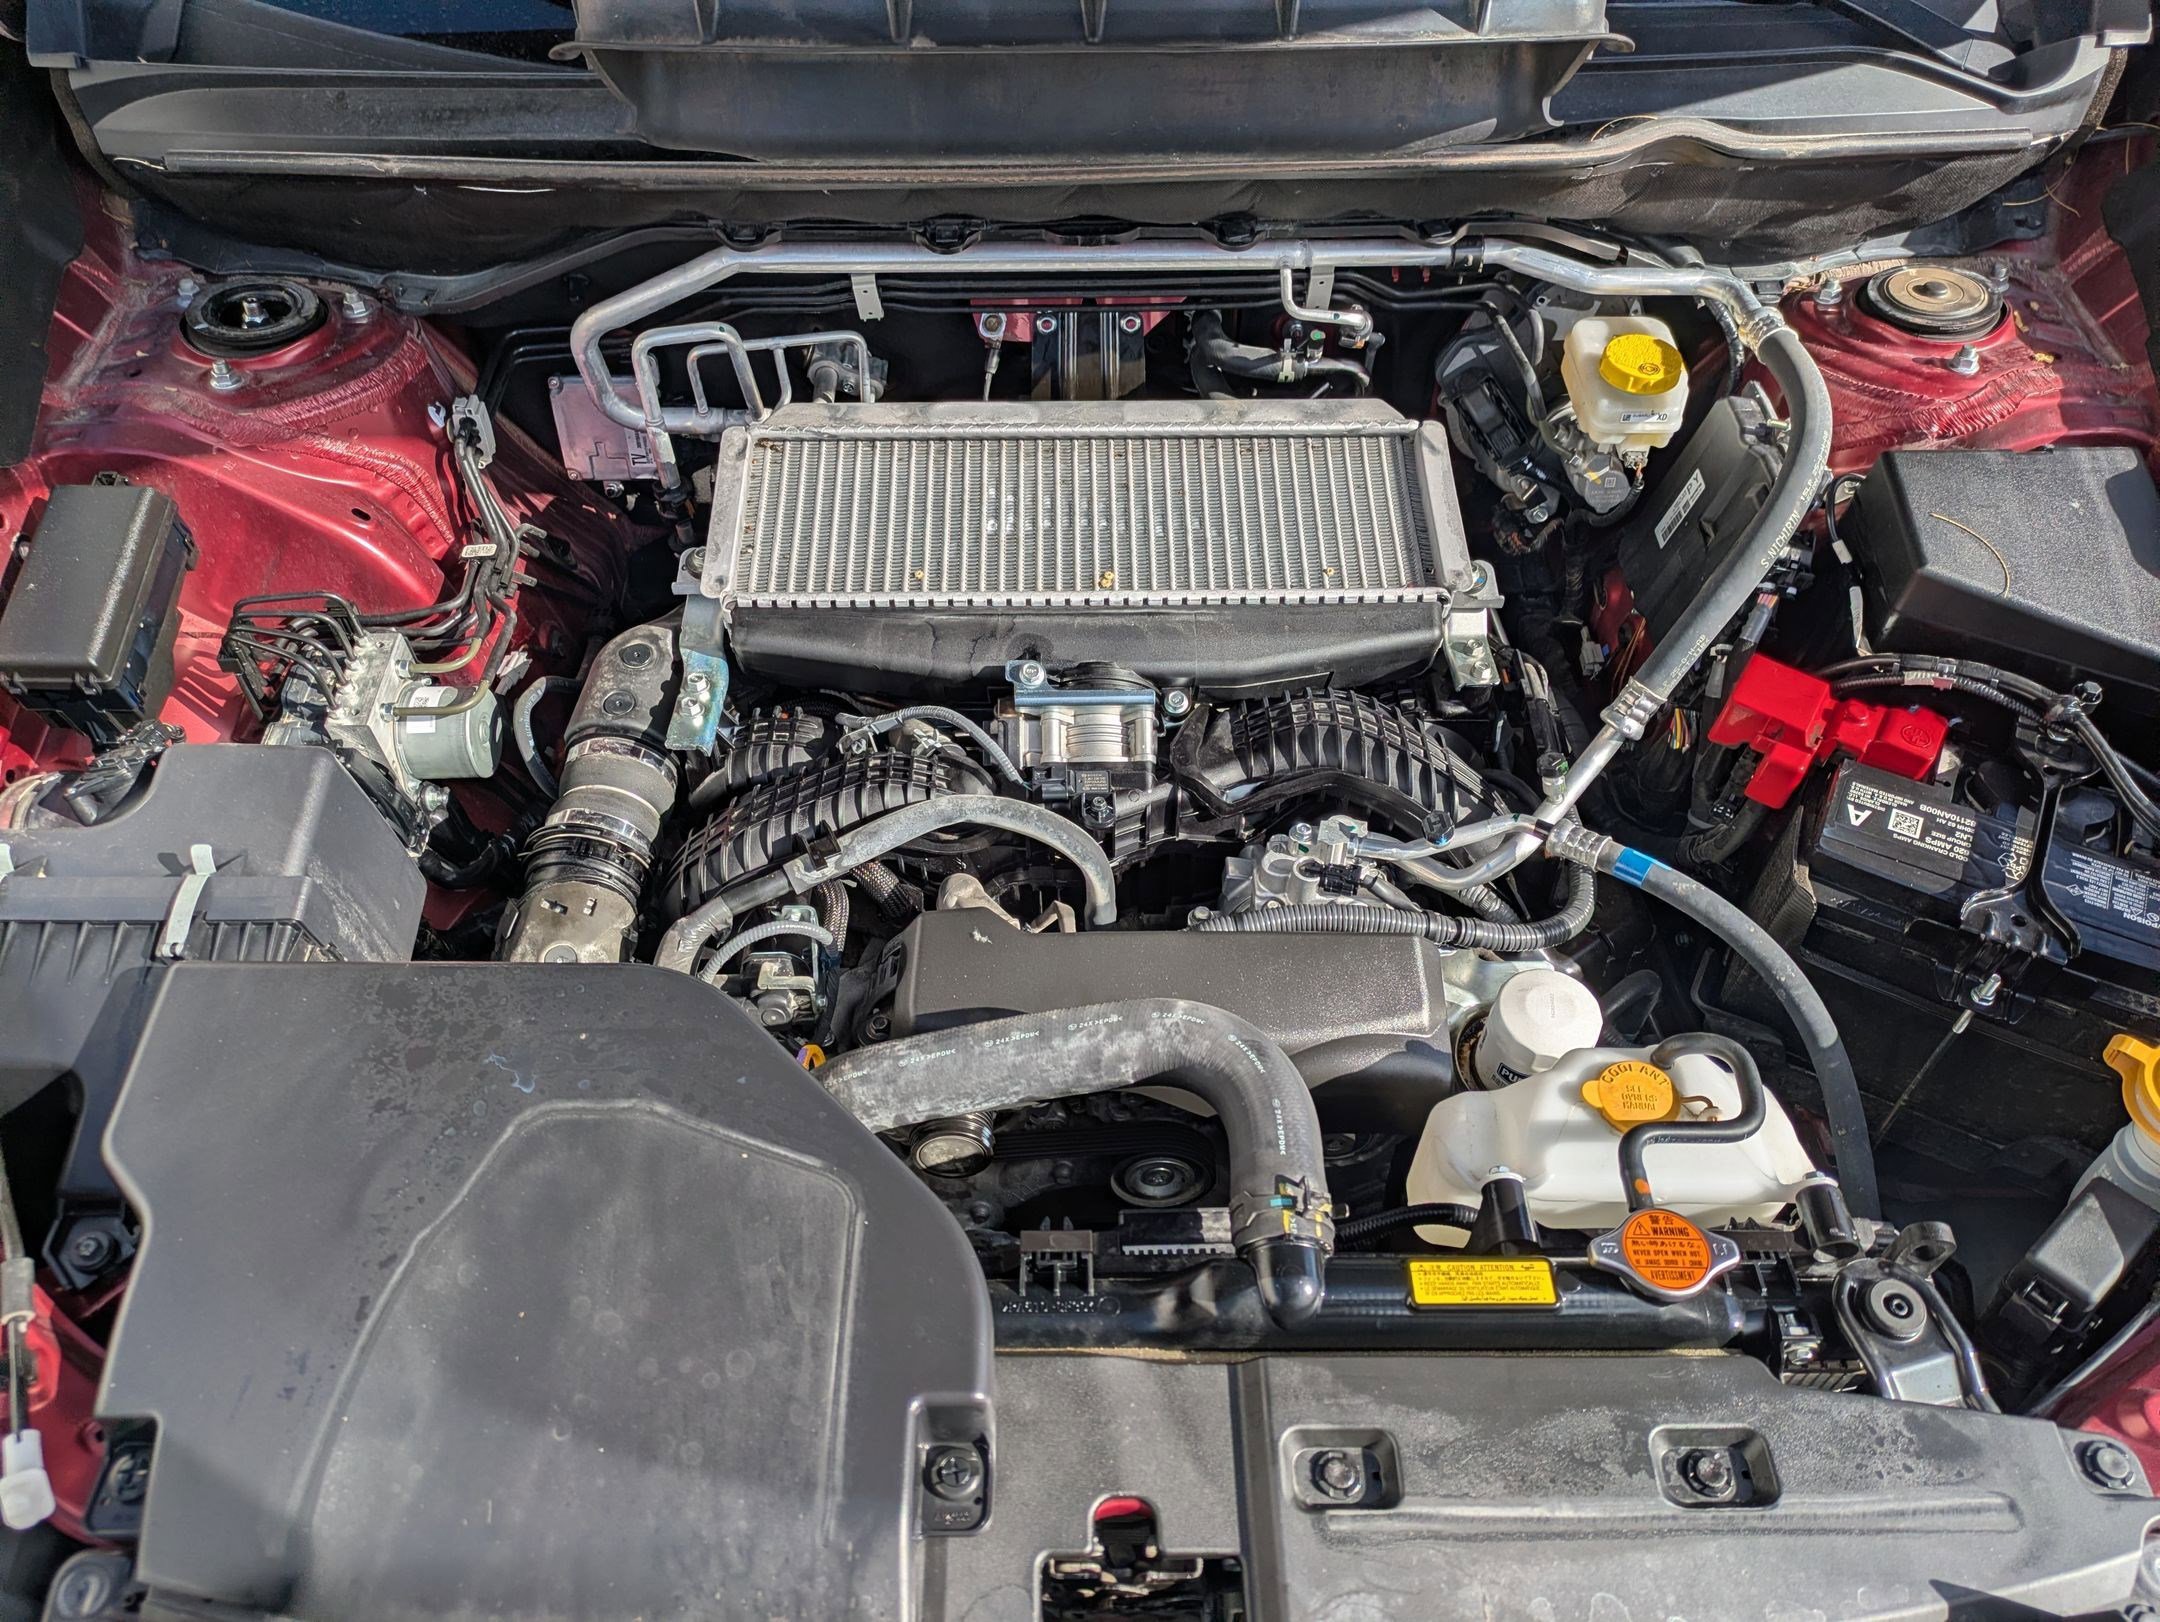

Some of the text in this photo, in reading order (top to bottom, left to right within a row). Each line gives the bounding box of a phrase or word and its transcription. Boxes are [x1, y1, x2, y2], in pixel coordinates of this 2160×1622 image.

[1847, 804, 1872, 827] A
[1931, 830, 1971, 847] GROUP SIZE
[1954, 831, 1973, 840] LN2
[1892, 832, 1968, 862] COLD CRANKING AMPS
[1924, 836, 1952, 849] AMPS
[1648, 1215, 1674, 1224] 警告
[1650, 1226, 1690, 1236] WARNING
[1447, 1264, 1475, 1272] CAUTION
